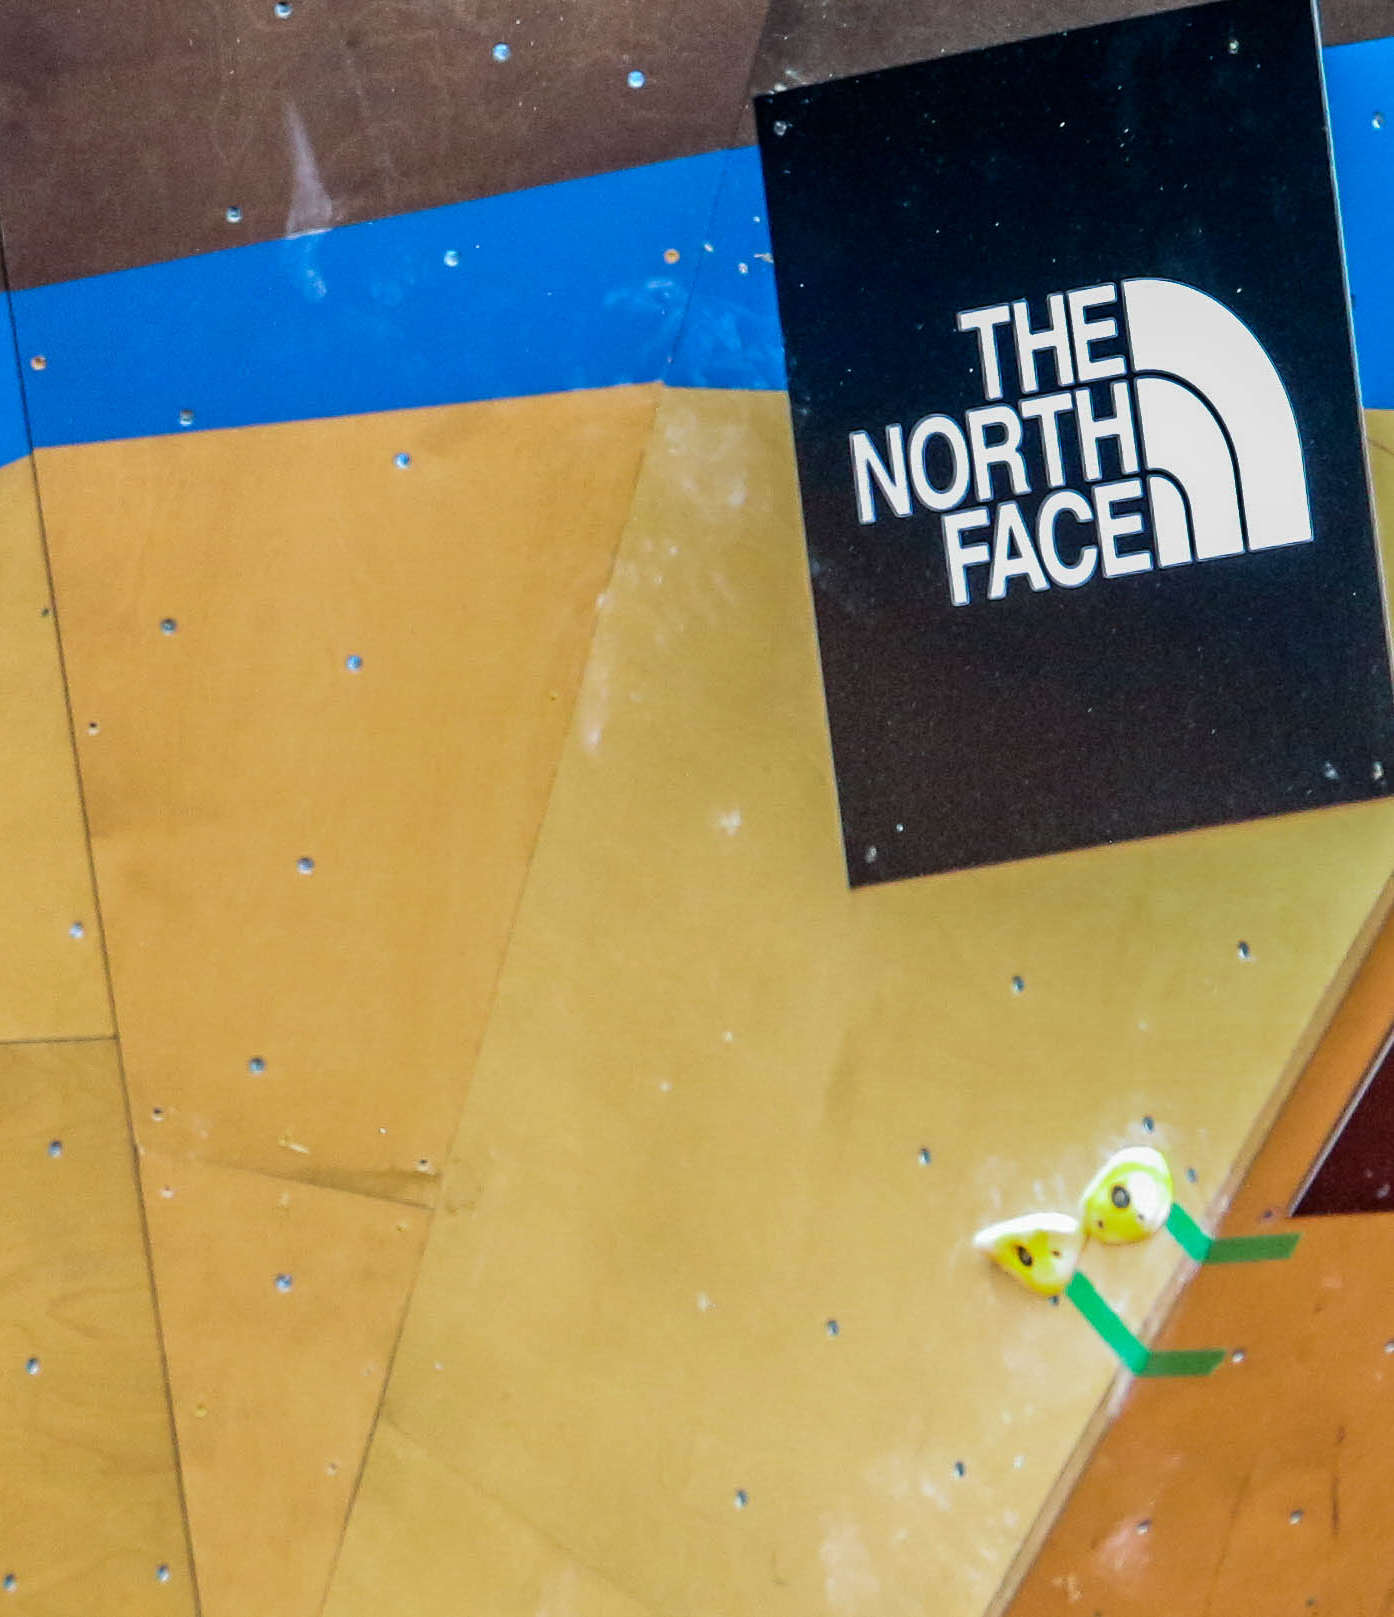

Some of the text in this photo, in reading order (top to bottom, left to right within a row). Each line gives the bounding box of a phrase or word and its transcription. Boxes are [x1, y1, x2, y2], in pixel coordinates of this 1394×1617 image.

[957, 280, 1126, 401] THE
[849, 377, 1139, 524] NORTH
[941, 476, 1154, 607] FACE
